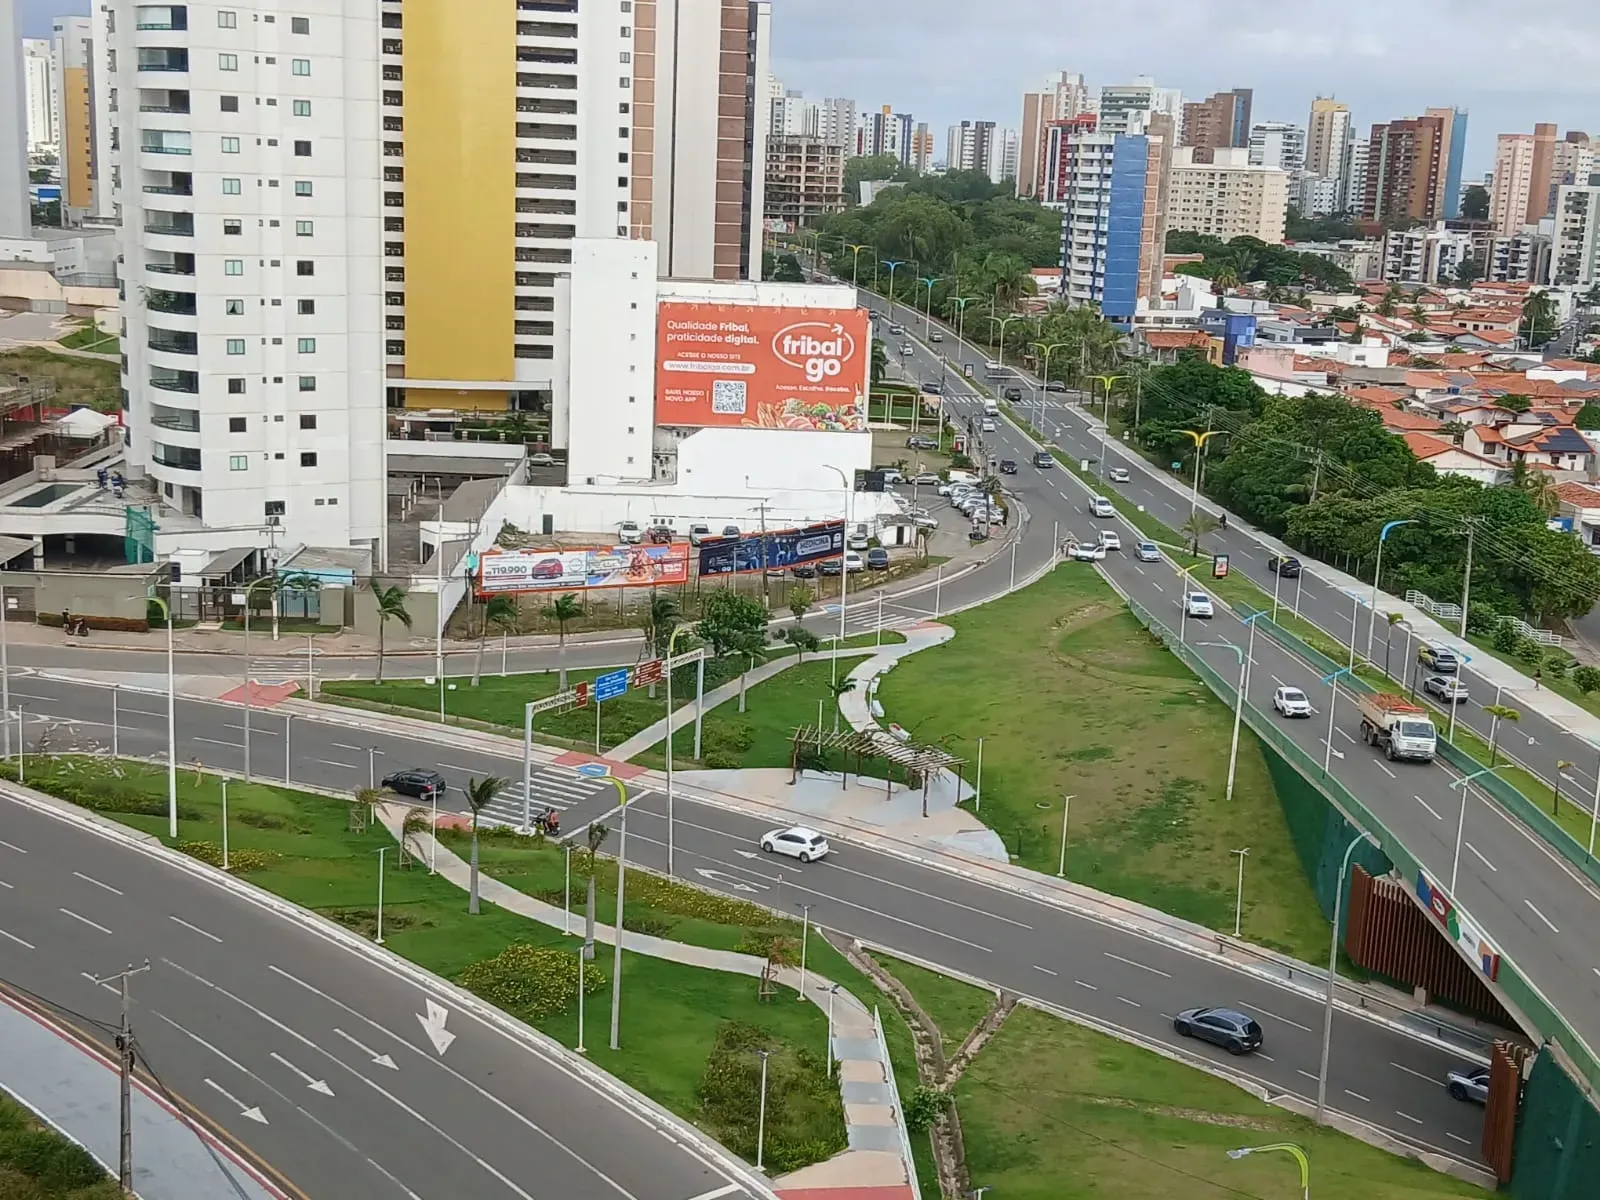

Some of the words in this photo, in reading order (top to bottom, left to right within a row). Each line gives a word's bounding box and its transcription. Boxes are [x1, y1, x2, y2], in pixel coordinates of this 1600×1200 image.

[667, 320, 718, 331] Qualidade
[719, 322, 749, 333] Fribal,
[667, 332, 723, 343] praticidade
[725, 334, 760, 345] digital.
[783, 334, 842, 356] fribal
[805, 357, 841, 383] go
